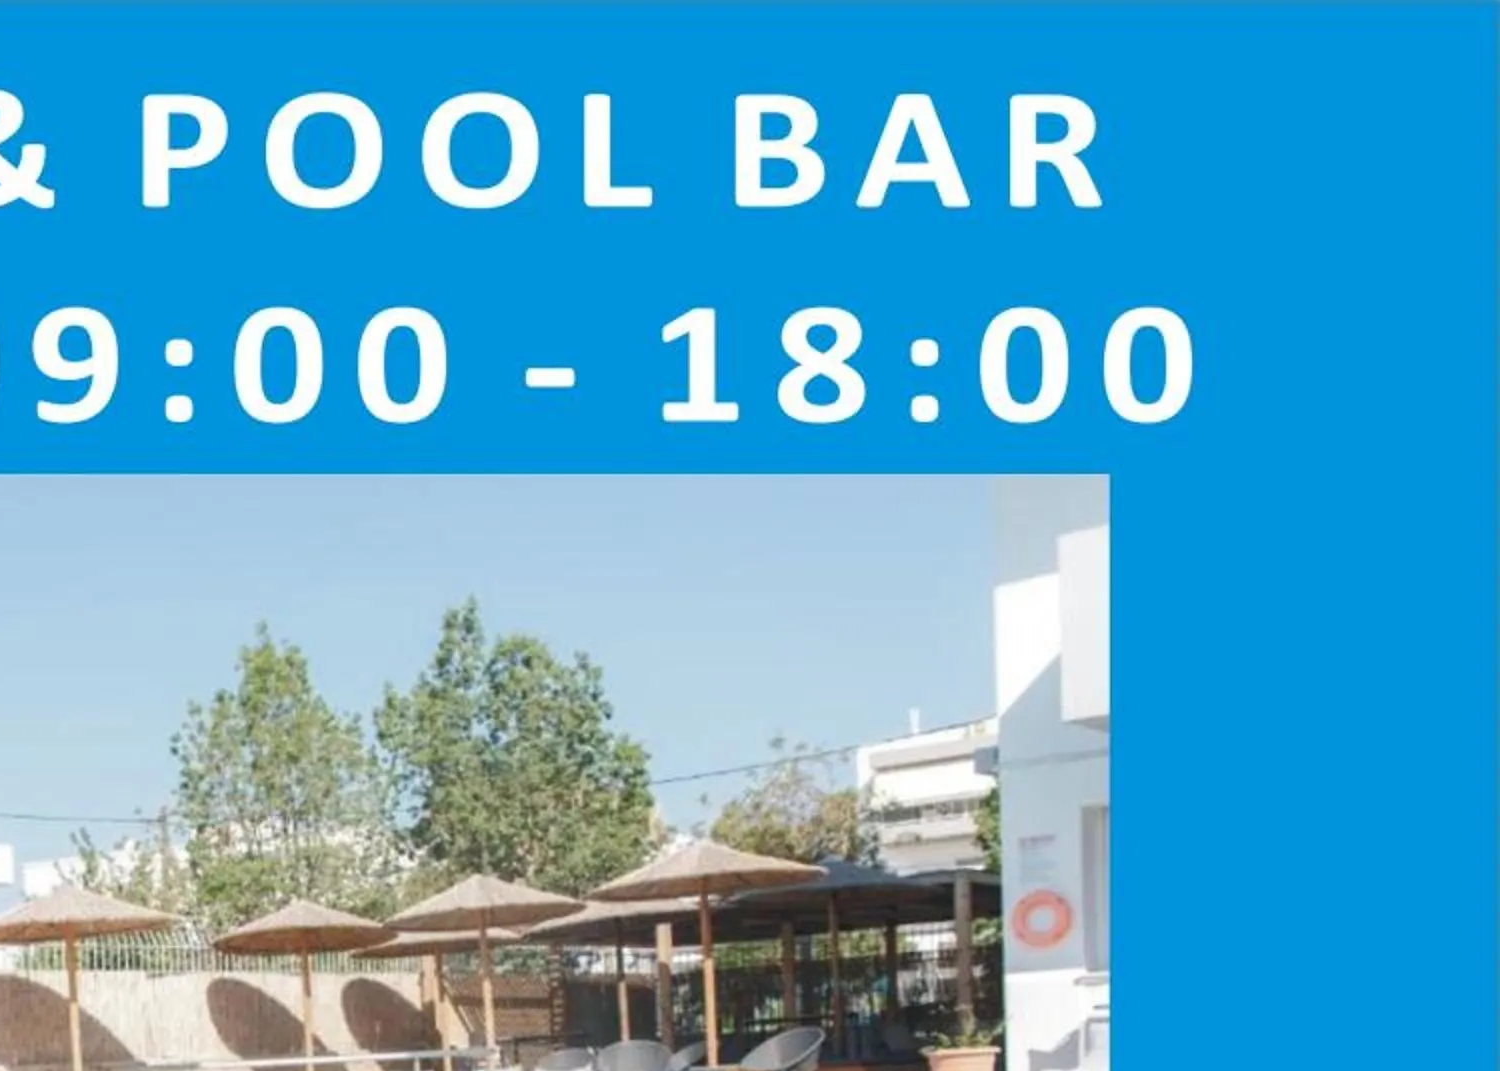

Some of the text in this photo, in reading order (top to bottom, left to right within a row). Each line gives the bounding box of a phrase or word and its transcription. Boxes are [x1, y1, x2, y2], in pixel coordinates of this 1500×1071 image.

[142, 92, 653, 208] POOL
[735, 94, 1102, 208] BAR
[525, 367, 575, 388] -
[662, 306, 1193, 424] 18:00
